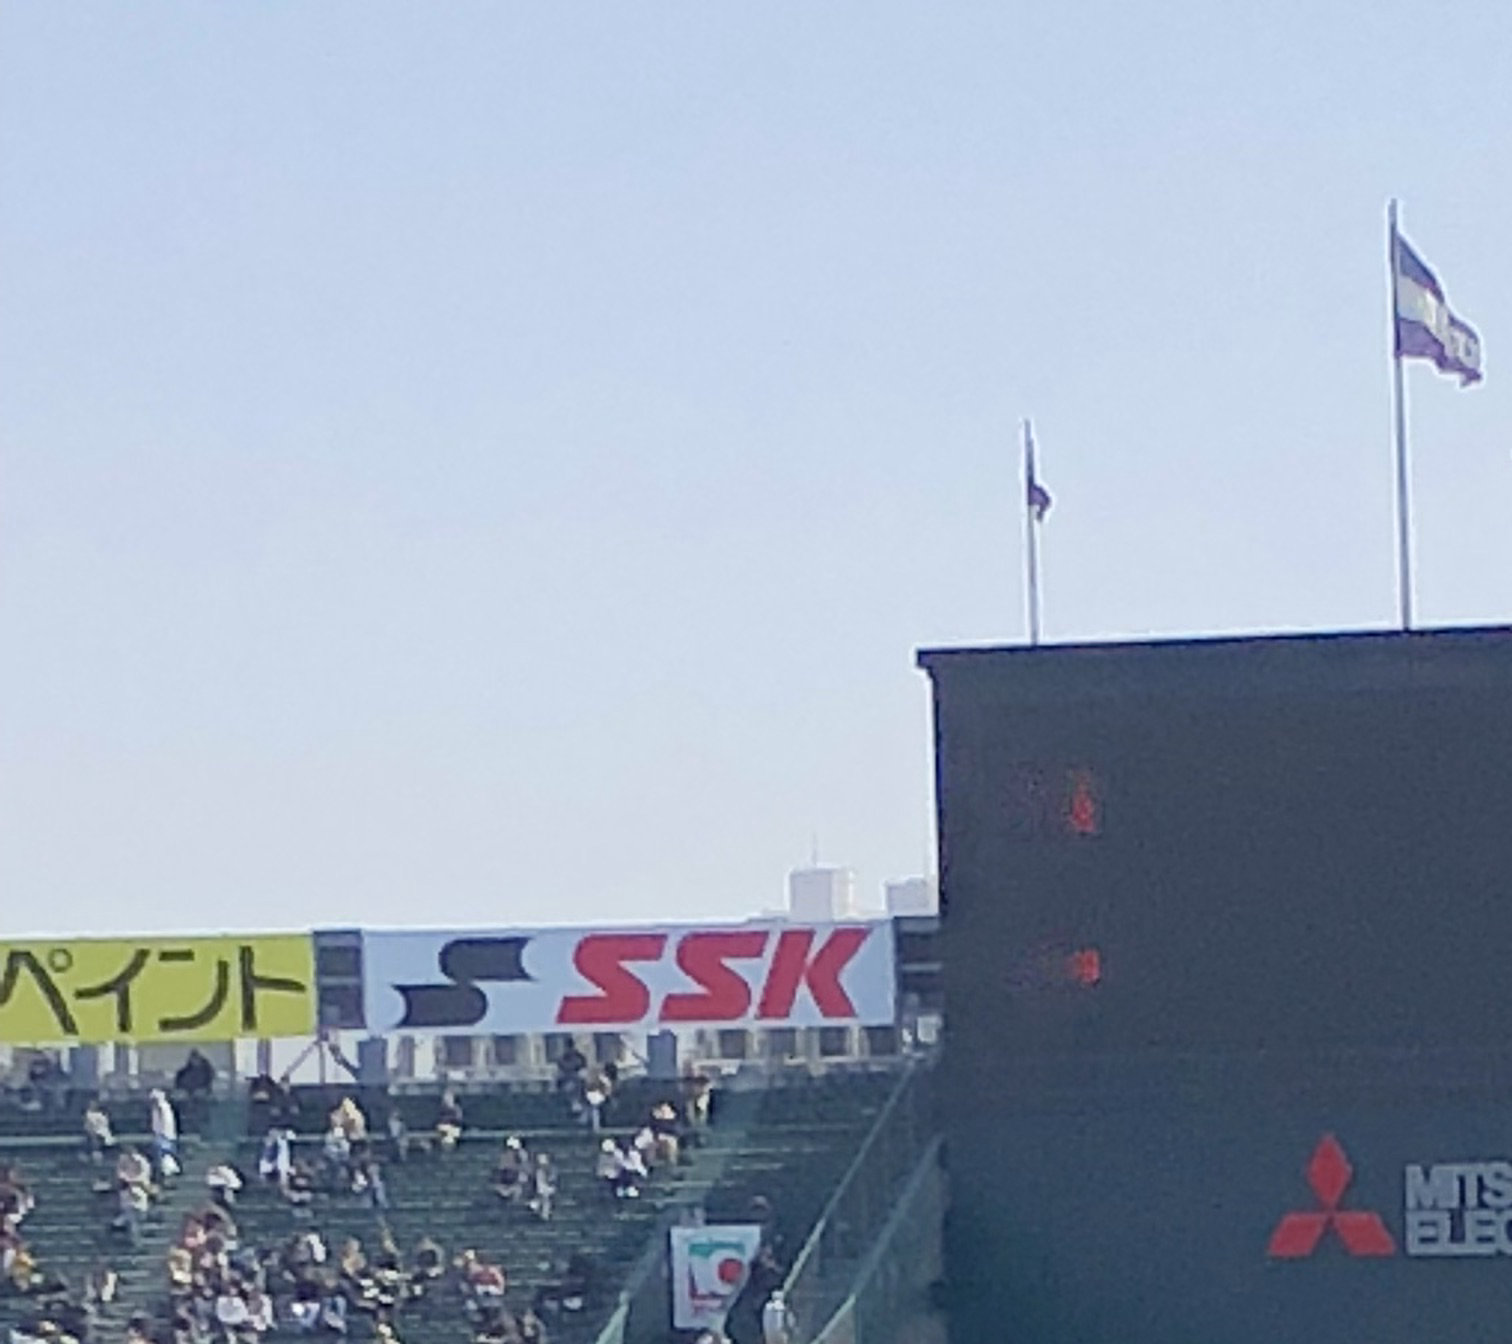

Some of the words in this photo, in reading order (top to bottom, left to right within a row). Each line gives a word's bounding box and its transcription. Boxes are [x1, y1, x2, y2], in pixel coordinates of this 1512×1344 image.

[0, 946, 306, 1034] ペイント
[555, 927, 872, 1024] SSK
